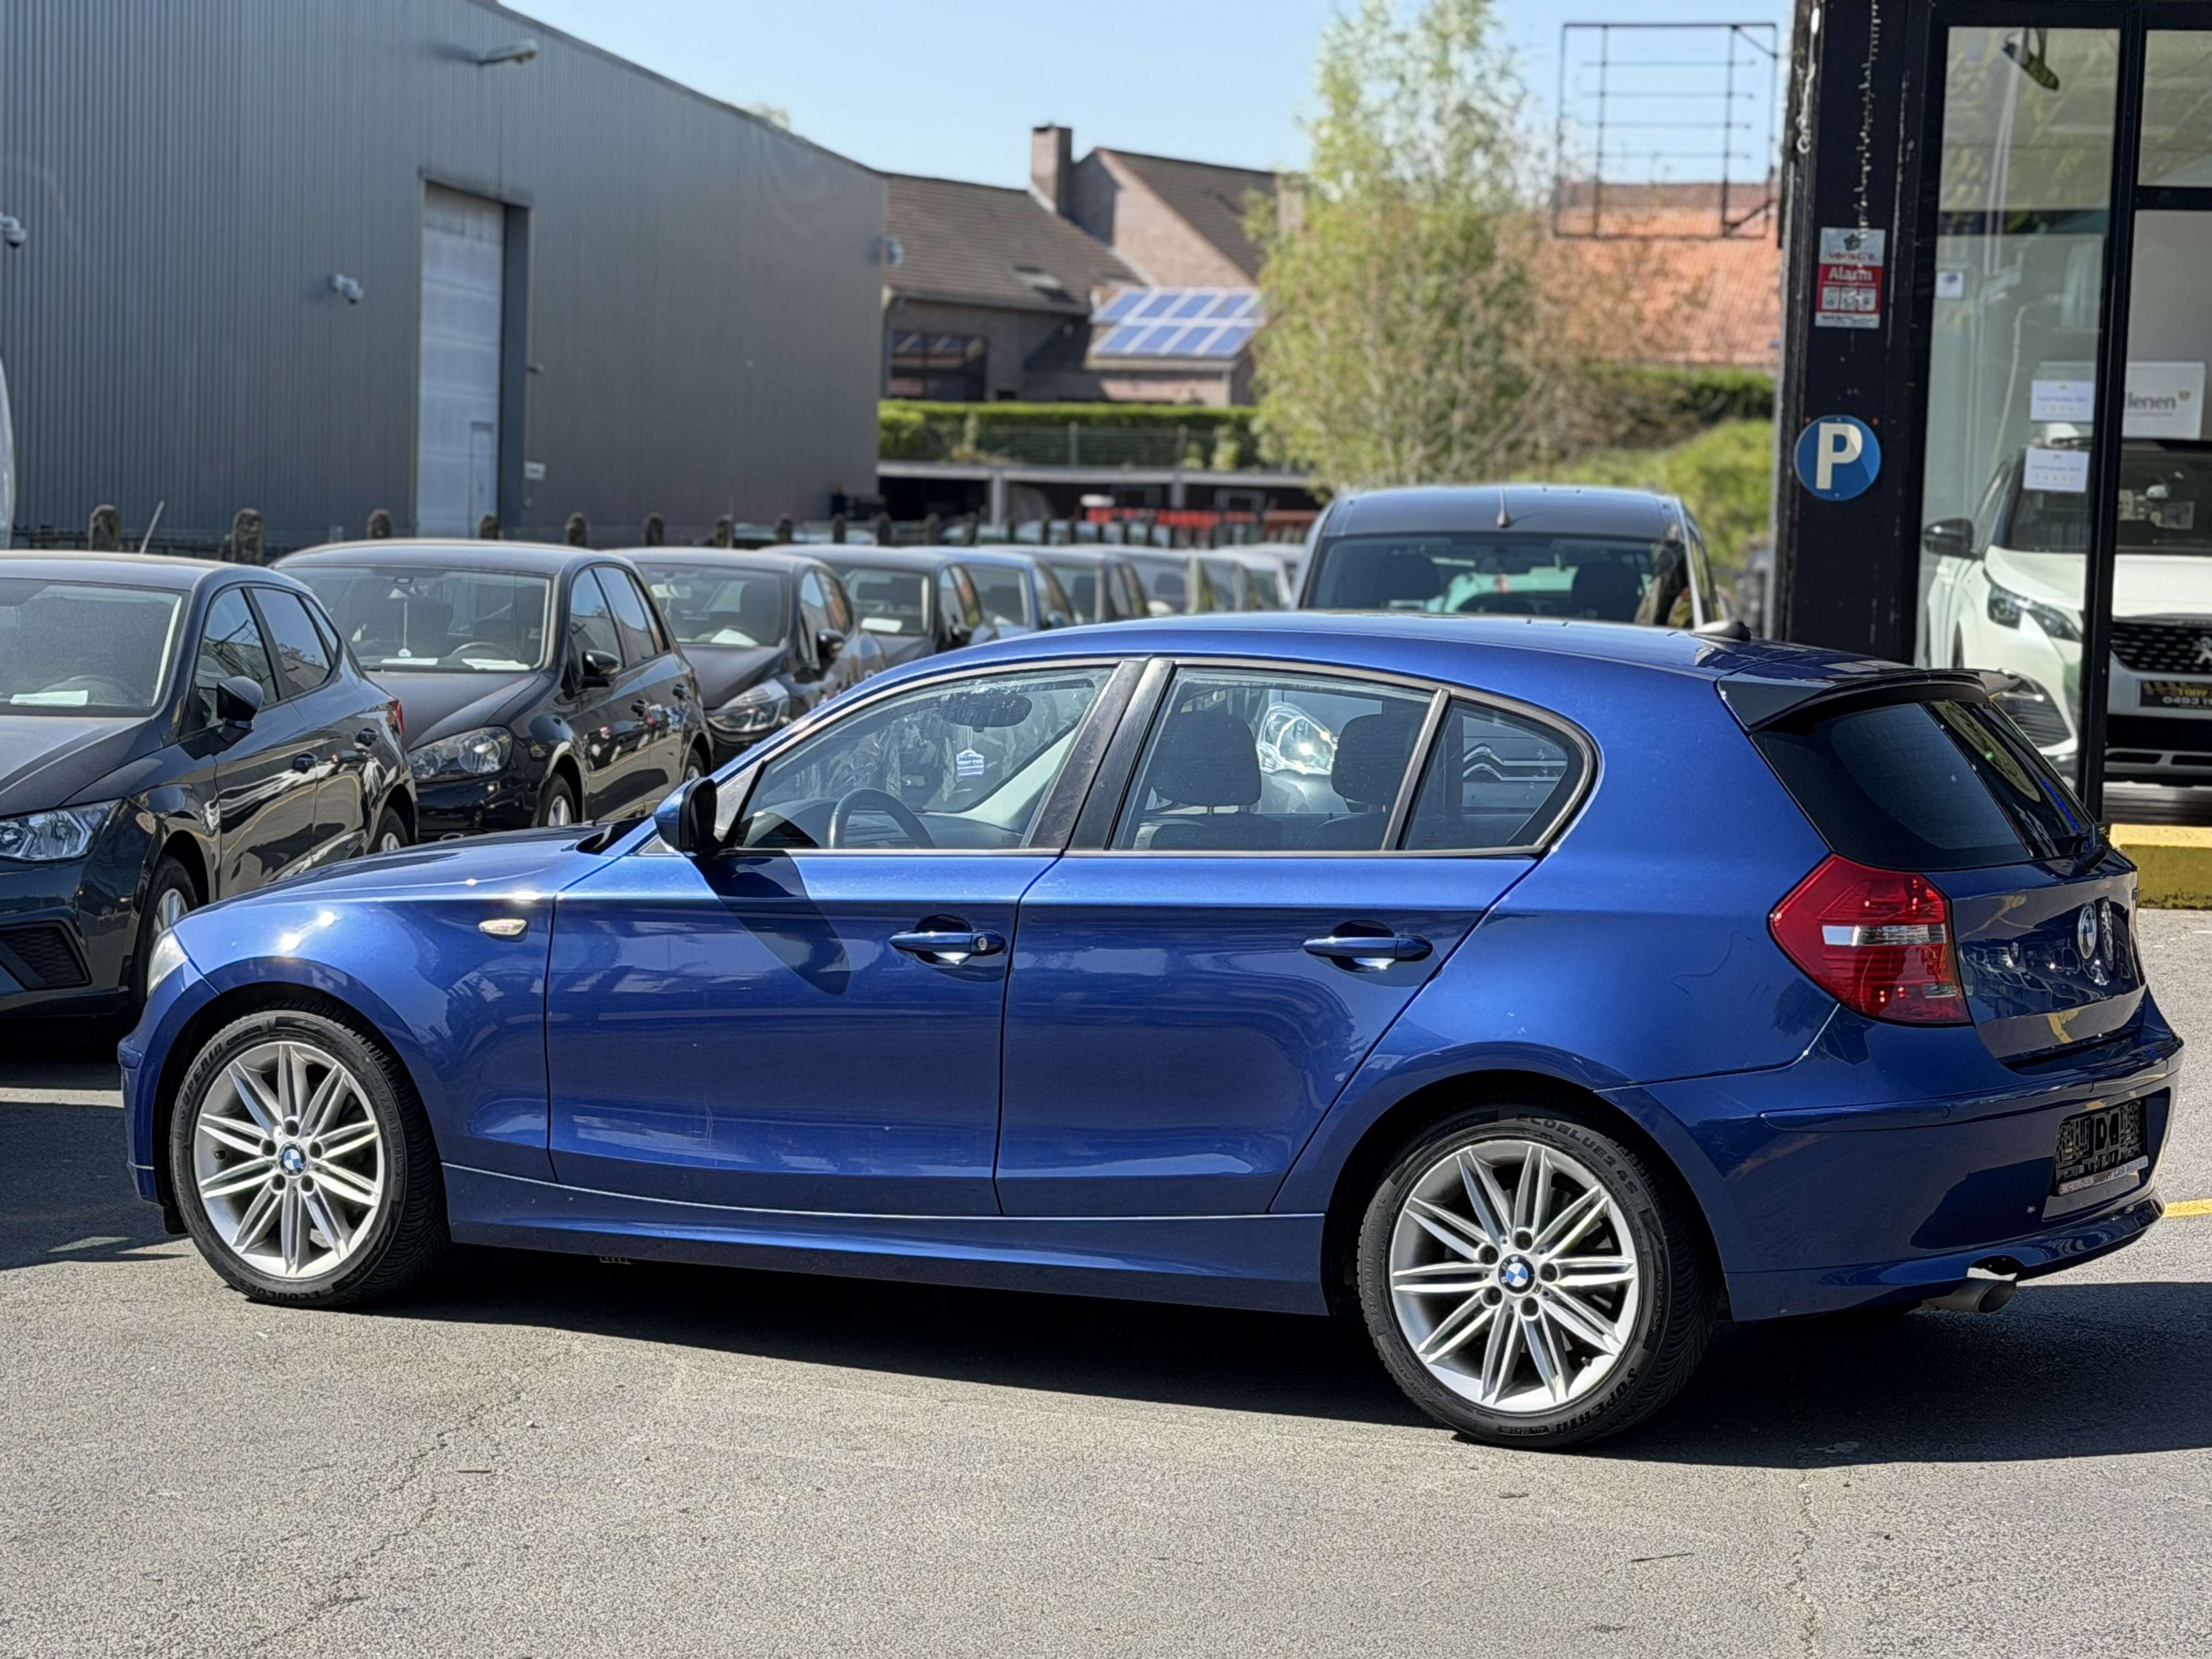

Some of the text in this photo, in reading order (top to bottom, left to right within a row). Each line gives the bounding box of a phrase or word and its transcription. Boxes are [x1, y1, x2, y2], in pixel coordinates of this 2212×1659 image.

[1829, 266, 1872, 281] Alarm
[1816, 422, 1863, 490] P
[1555, 1367, 1638, 1434] SUPERIA
